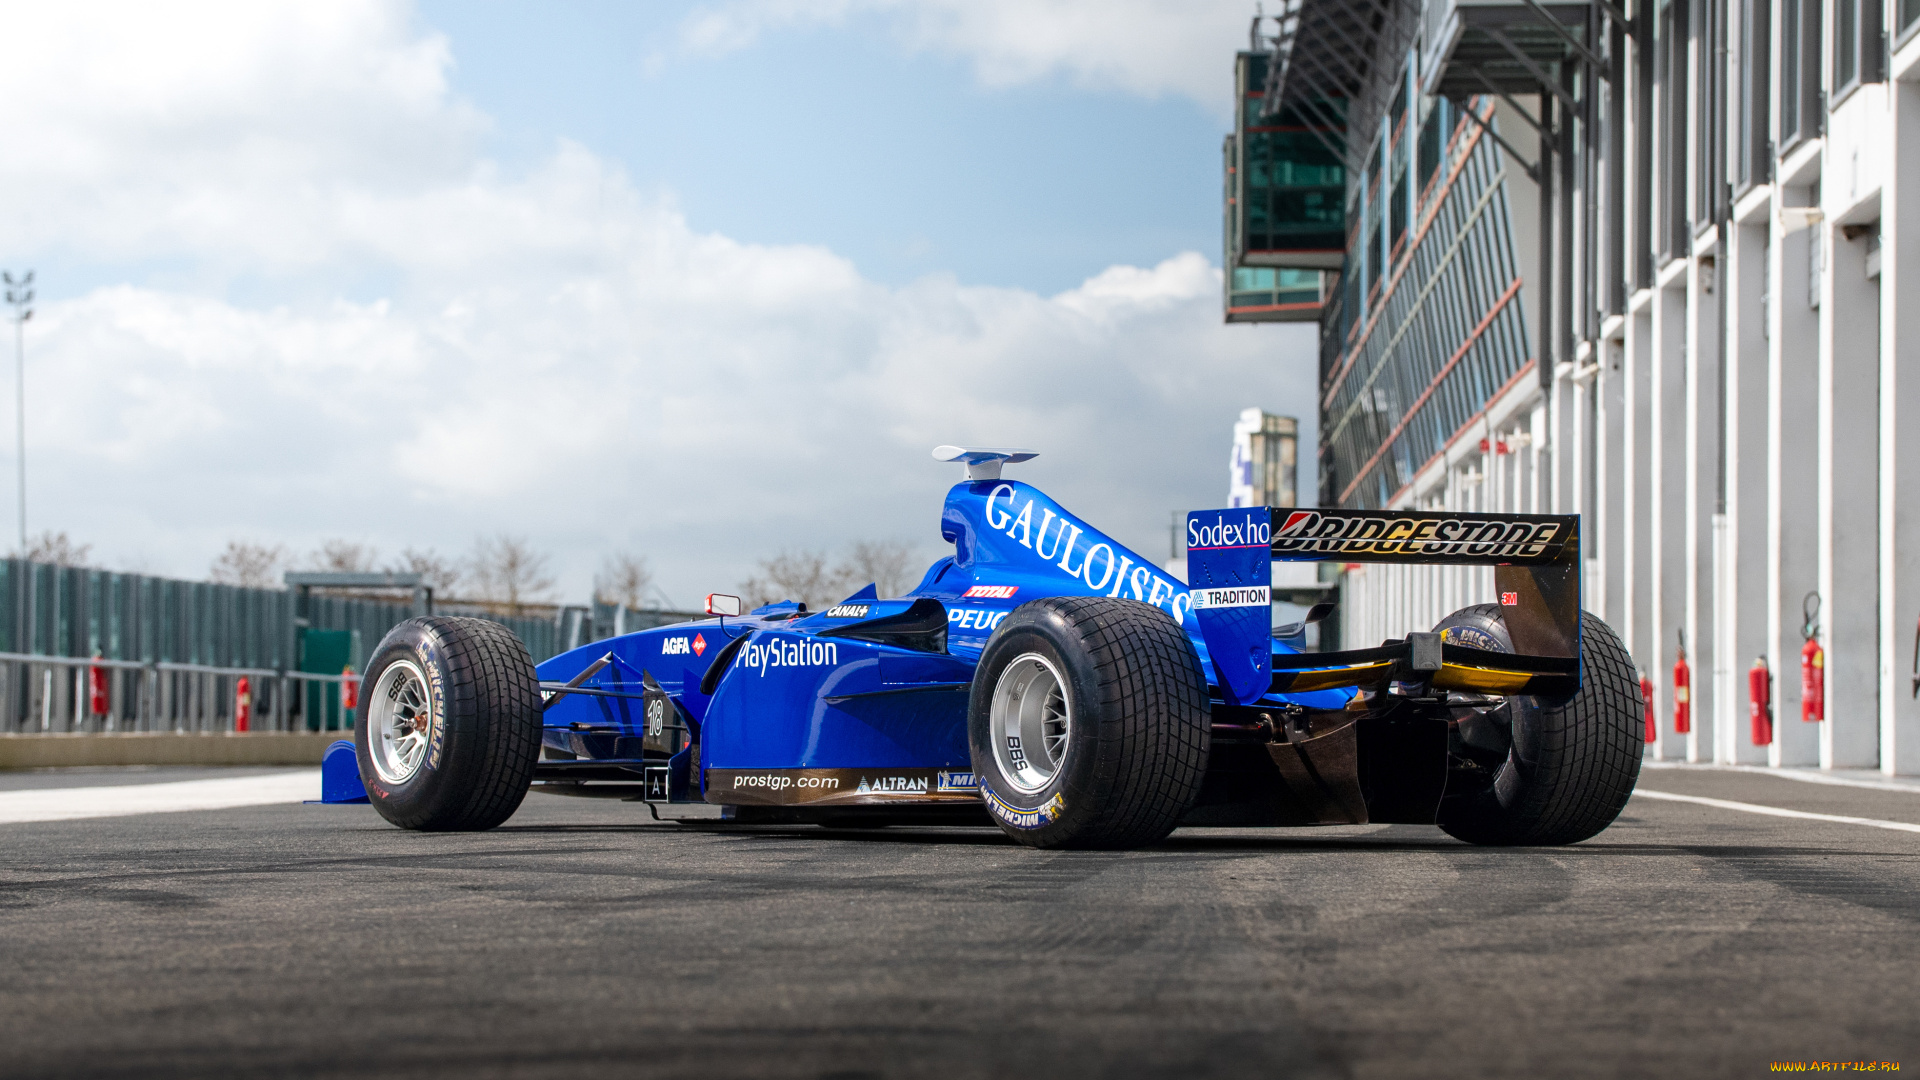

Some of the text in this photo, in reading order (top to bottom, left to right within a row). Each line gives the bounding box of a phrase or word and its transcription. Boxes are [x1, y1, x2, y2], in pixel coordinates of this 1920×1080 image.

[1187, 513, 1270, 547] Sodexho
[1272, 511, 1560, 556] BRIDGESTONE
[986, 484, 1192, 626] GAULOISES
[966, 586, 1015, 598] TOTAL
[1208, 589, 1266, 605] TRADITION
[1501, 592, 1518, 605] 3M
[827, 605, 869, 617] CANAL+
[662, 637, 690, 654] AGFA
[735, 637, 837, 678] PlayStation
[388, 671, 407, 702] BBS
[647, 699, 663, 736] 18
[1007, 736, 1029, 770] BBS
[652, 776, 660, 795] A
[733, 774, 839, 790] prostgp.com
[871, 777, 928, 791] ALTRAN
[980, 785, 1039, 827] MICHELIN
